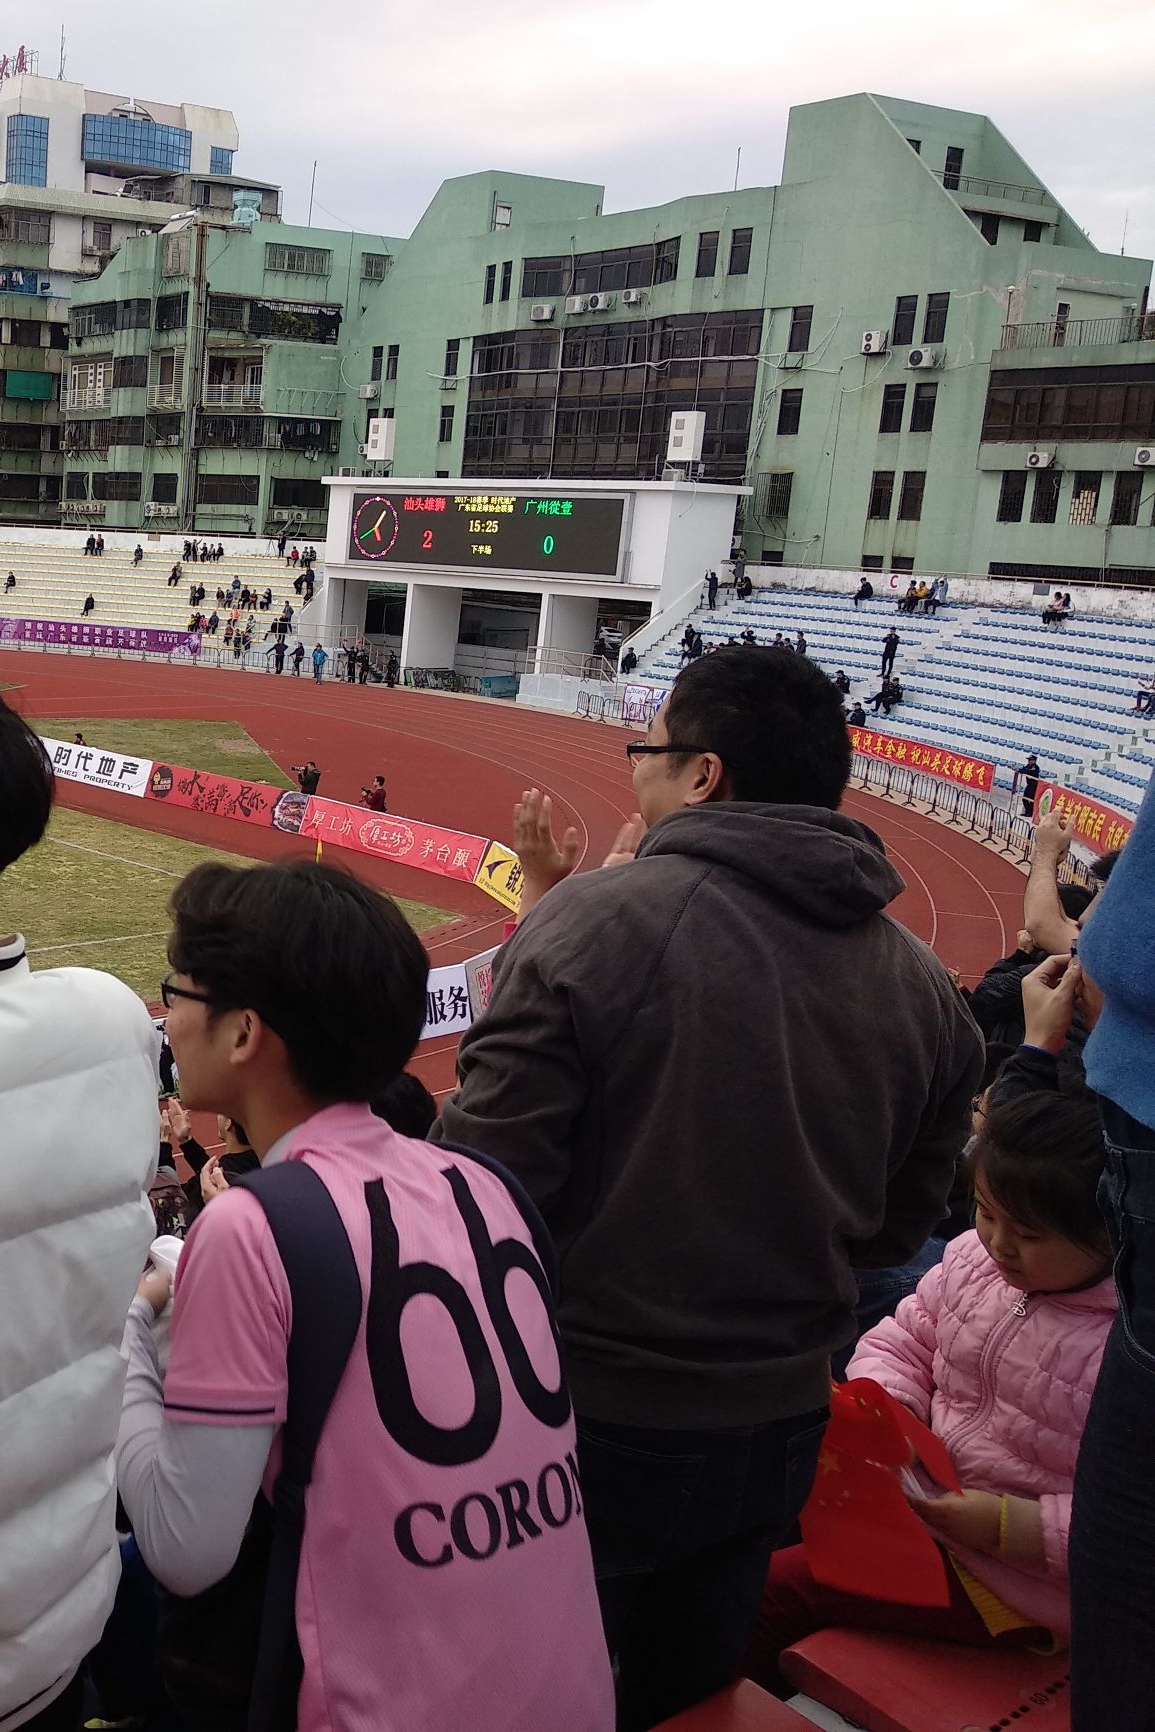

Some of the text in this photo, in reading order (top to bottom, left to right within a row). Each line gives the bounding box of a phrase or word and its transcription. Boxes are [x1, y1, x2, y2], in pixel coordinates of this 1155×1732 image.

[404, 496, 447, 512] 汕头雄狮
[468, 519, 499, 533] 15:25
[422, 529, 433, 549] 2
[543, 535, 554, 555] 0
[471, 544, 492, 555] 下半场
[53, 746, 140, 780] 时代地产
[83, 774, 133, 791] PROPERTY
[426, 985, 469, 1026] 服务
